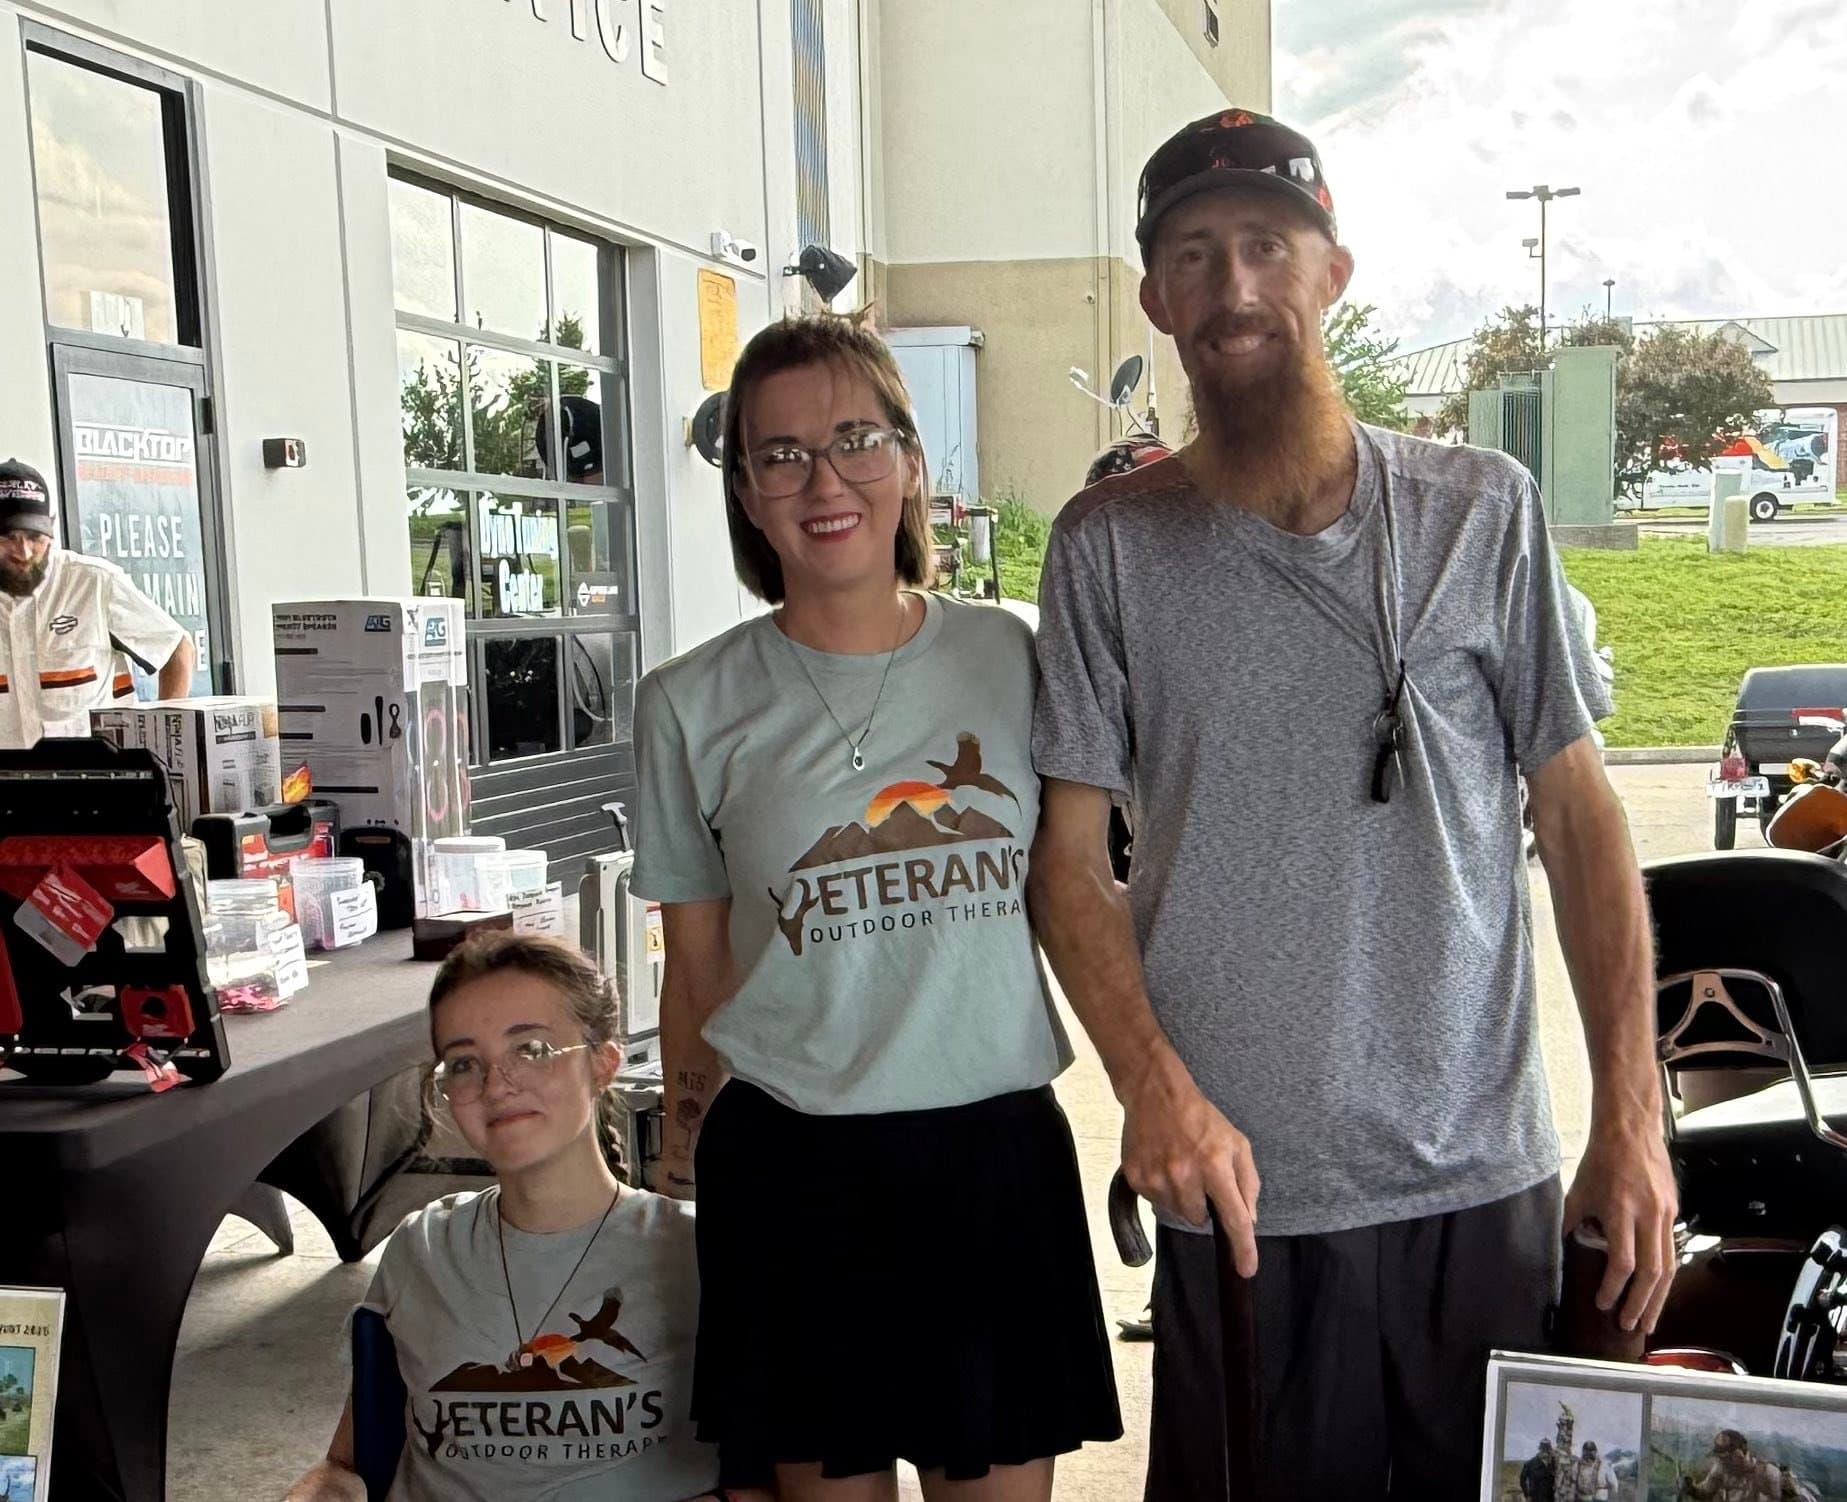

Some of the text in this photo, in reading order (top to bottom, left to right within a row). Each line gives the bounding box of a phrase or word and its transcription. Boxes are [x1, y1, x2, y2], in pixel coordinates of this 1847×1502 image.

[75, 426, 192, 462] BLACKTOP
[101, 513, 185, 558] PLEASE
[143, 572, 199, 616] MAIN
[810, 898, 1023, 943] OUTDOOR THERA
[446, 1443, 549, 1461] OUTDOOR
